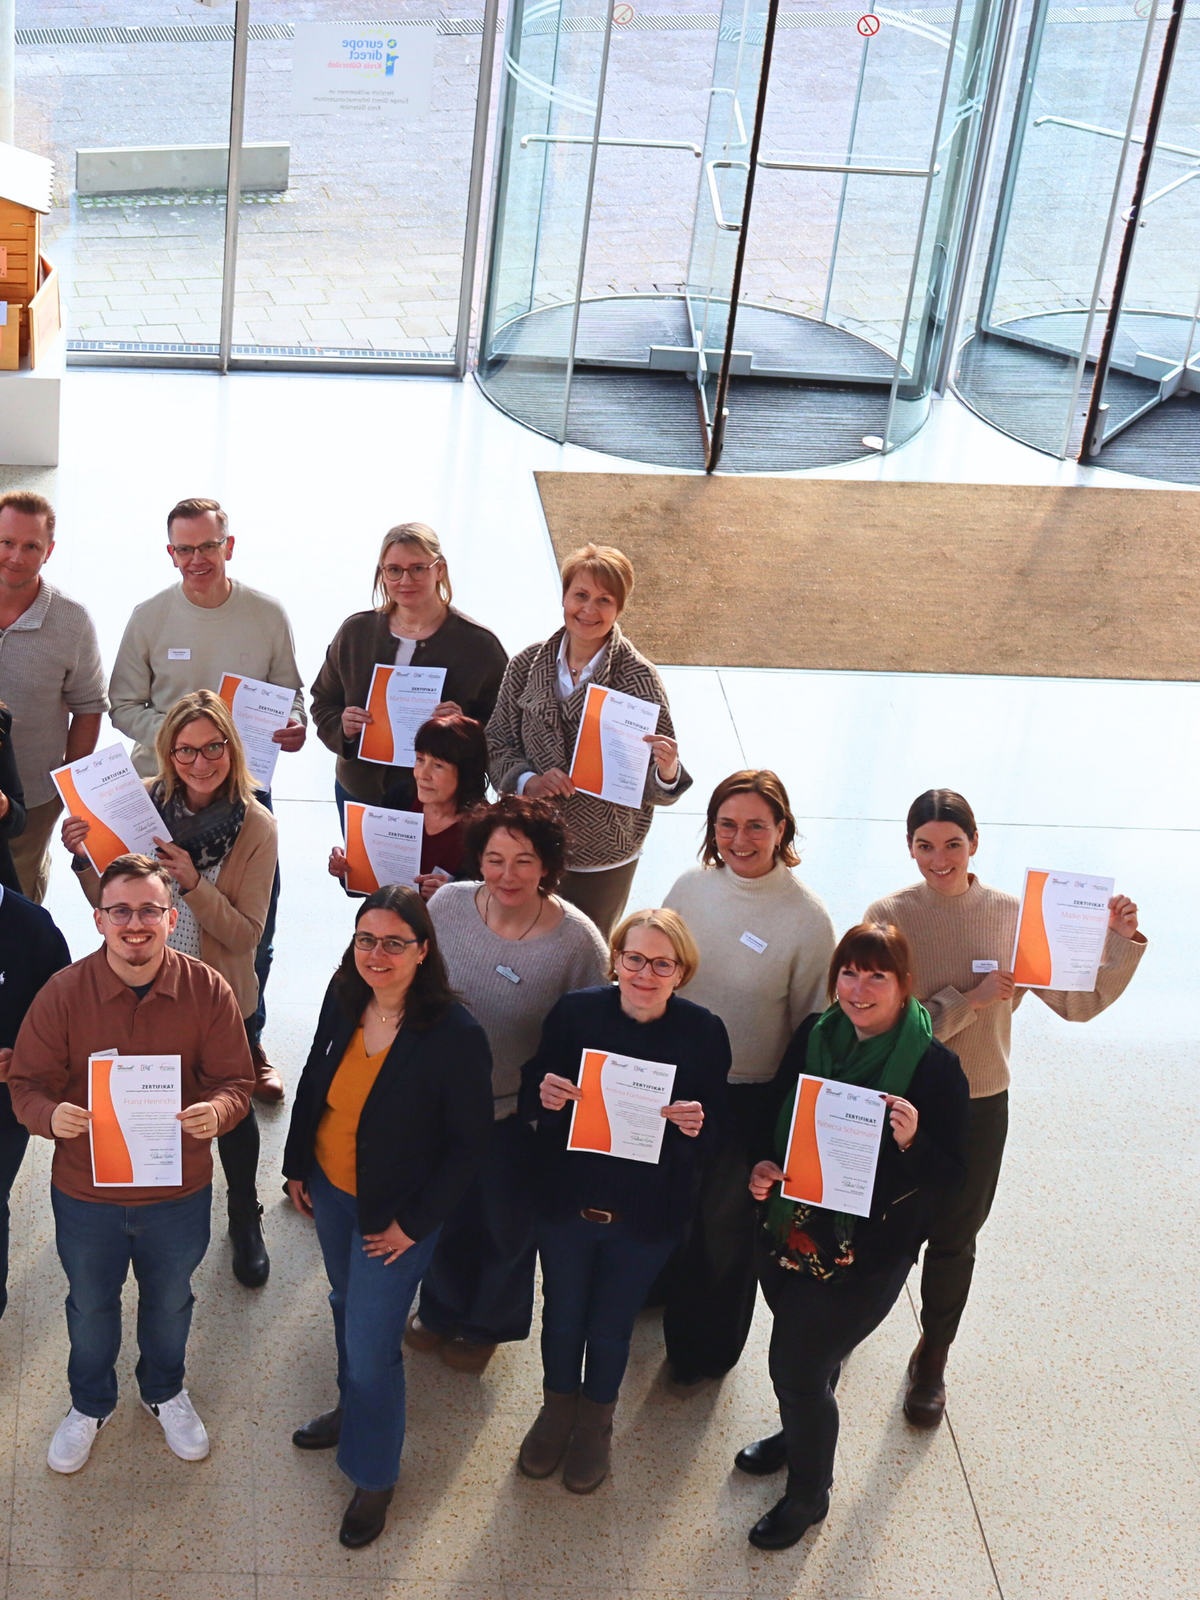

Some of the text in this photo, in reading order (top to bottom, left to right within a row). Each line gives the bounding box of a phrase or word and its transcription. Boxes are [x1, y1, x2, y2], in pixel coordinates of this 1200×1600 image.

[102, 768, 129, 782] ZERTIFIKAT
[632, 1082, 665, 1091] ZERTIFIKAT
[845, 1113, 876, 1123] ZERTIFIKAT
[817, 1120, 842, 1130] Rebecca
